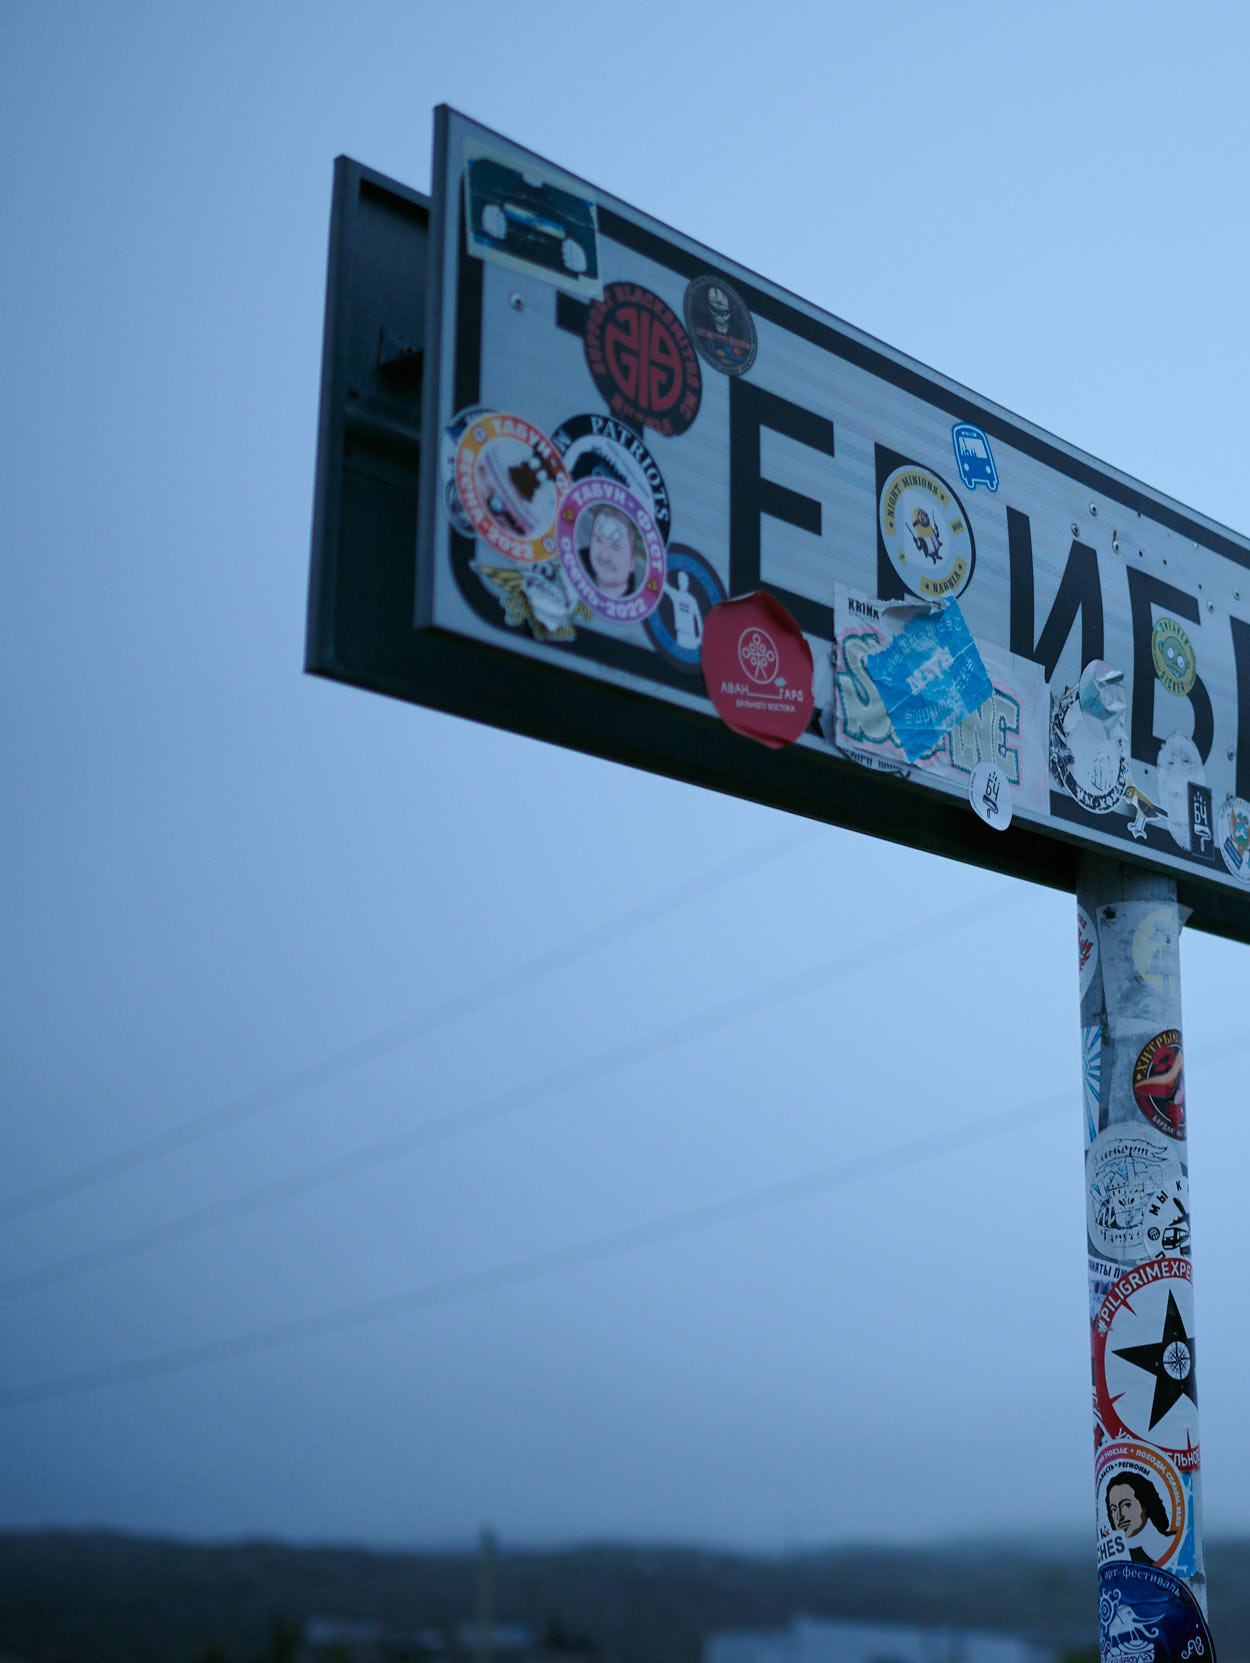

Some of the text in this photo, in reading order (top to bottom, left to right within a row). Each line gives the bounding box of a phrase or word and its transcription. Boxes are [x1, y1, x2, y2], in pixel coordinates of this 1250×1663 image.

[591, 416, 669, 522] PATRIOTS
[887, 475, 938, 518] NIGHT MINIONS
[931, 571, 961, 593] NARNIA
[847, 597, 880, 620] KRINK
[720, 680, 750, 696] АВАН
[1098, 1260, 1192, 1333] #PILIGRIMEXPE
[1118, 1461, 1151, 1476] РЕГИОНЫ
[1104, 1565, 1182, 1597] арт-фестиваль
